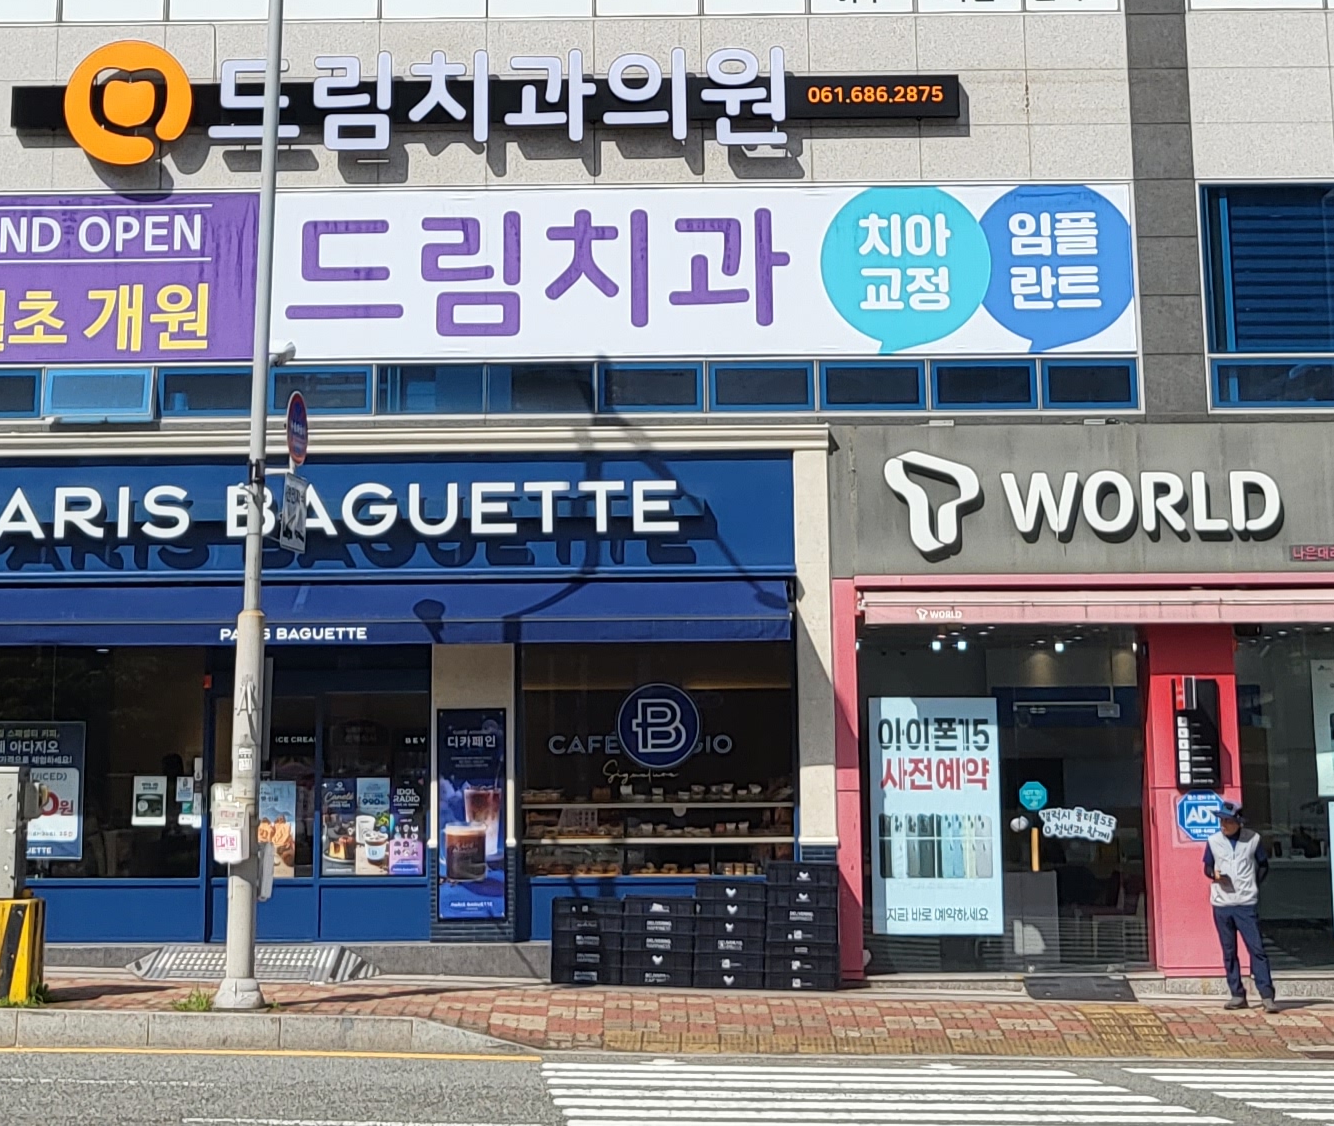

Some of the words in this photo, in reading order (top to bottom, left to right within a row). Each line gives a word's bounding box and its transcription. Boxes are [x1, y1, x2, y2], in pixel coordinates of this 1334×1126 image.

[208, 47, 787, 151] 드림치과의원
[807, 85, 944, 104] 061.686.2875
[78, 214, 202, 252] OPEN
[858, 212, 950, 257] 치아
[1008, 211, 1098, 258] 임플
[285, 207, 791, 338] 드림치과
[859, 265, 950, 312] 교정
[1010, 266, 1102, 310] 란트
[83, 282, 209, 351] 개원
[226, 480, 680, 538] BAGUETTE
[1000, 470, 1281, 531] WORLD
[276, 627, 367, 640] BAGUETTE
[930, 610, 962, 618] WORLD
[9, 740, 60, 754] 아다지오
[447, 735, 496, 747] 디카페인
[881, 757, 990, 791] 사전예약
[1186, 805, 1219, 824] ADT
[912, 907, 932, 921] 바로
